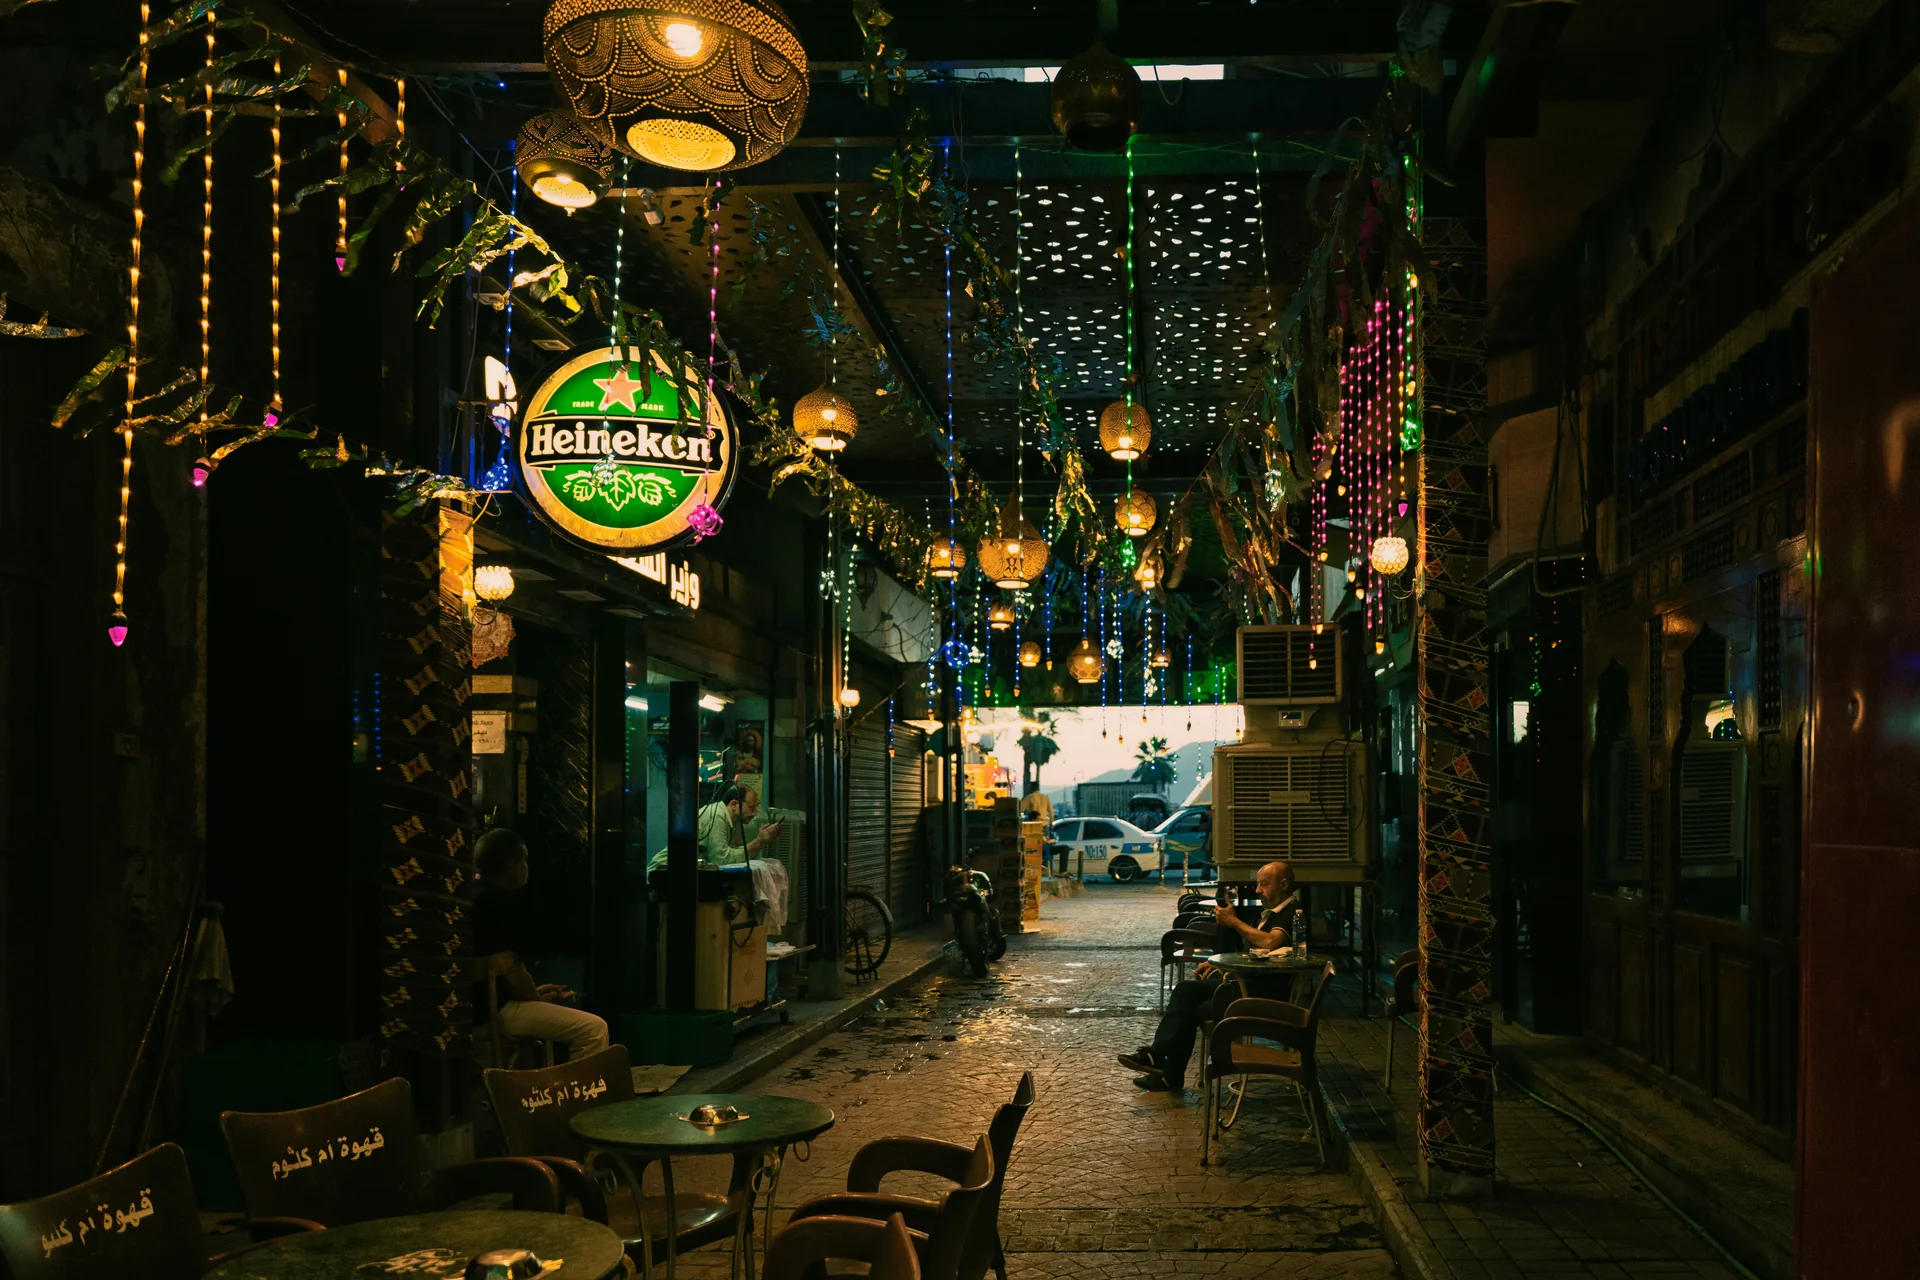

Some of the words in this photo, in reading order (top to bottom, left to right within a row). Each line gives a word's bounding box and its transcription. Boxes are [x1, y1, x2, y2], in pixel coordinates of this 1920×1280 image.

[572, 400, 594, 409] TRADE
[641, 403, 664, 412] MARK
[531, 421, 714, 463] Heineken
[670, 560, 700, 610] وزير
[337, 1126, 385, 1161] قهوة
[272, 1146, 313, 1181] كلثوم
[96, 1187, 154, 1233] قهوة
